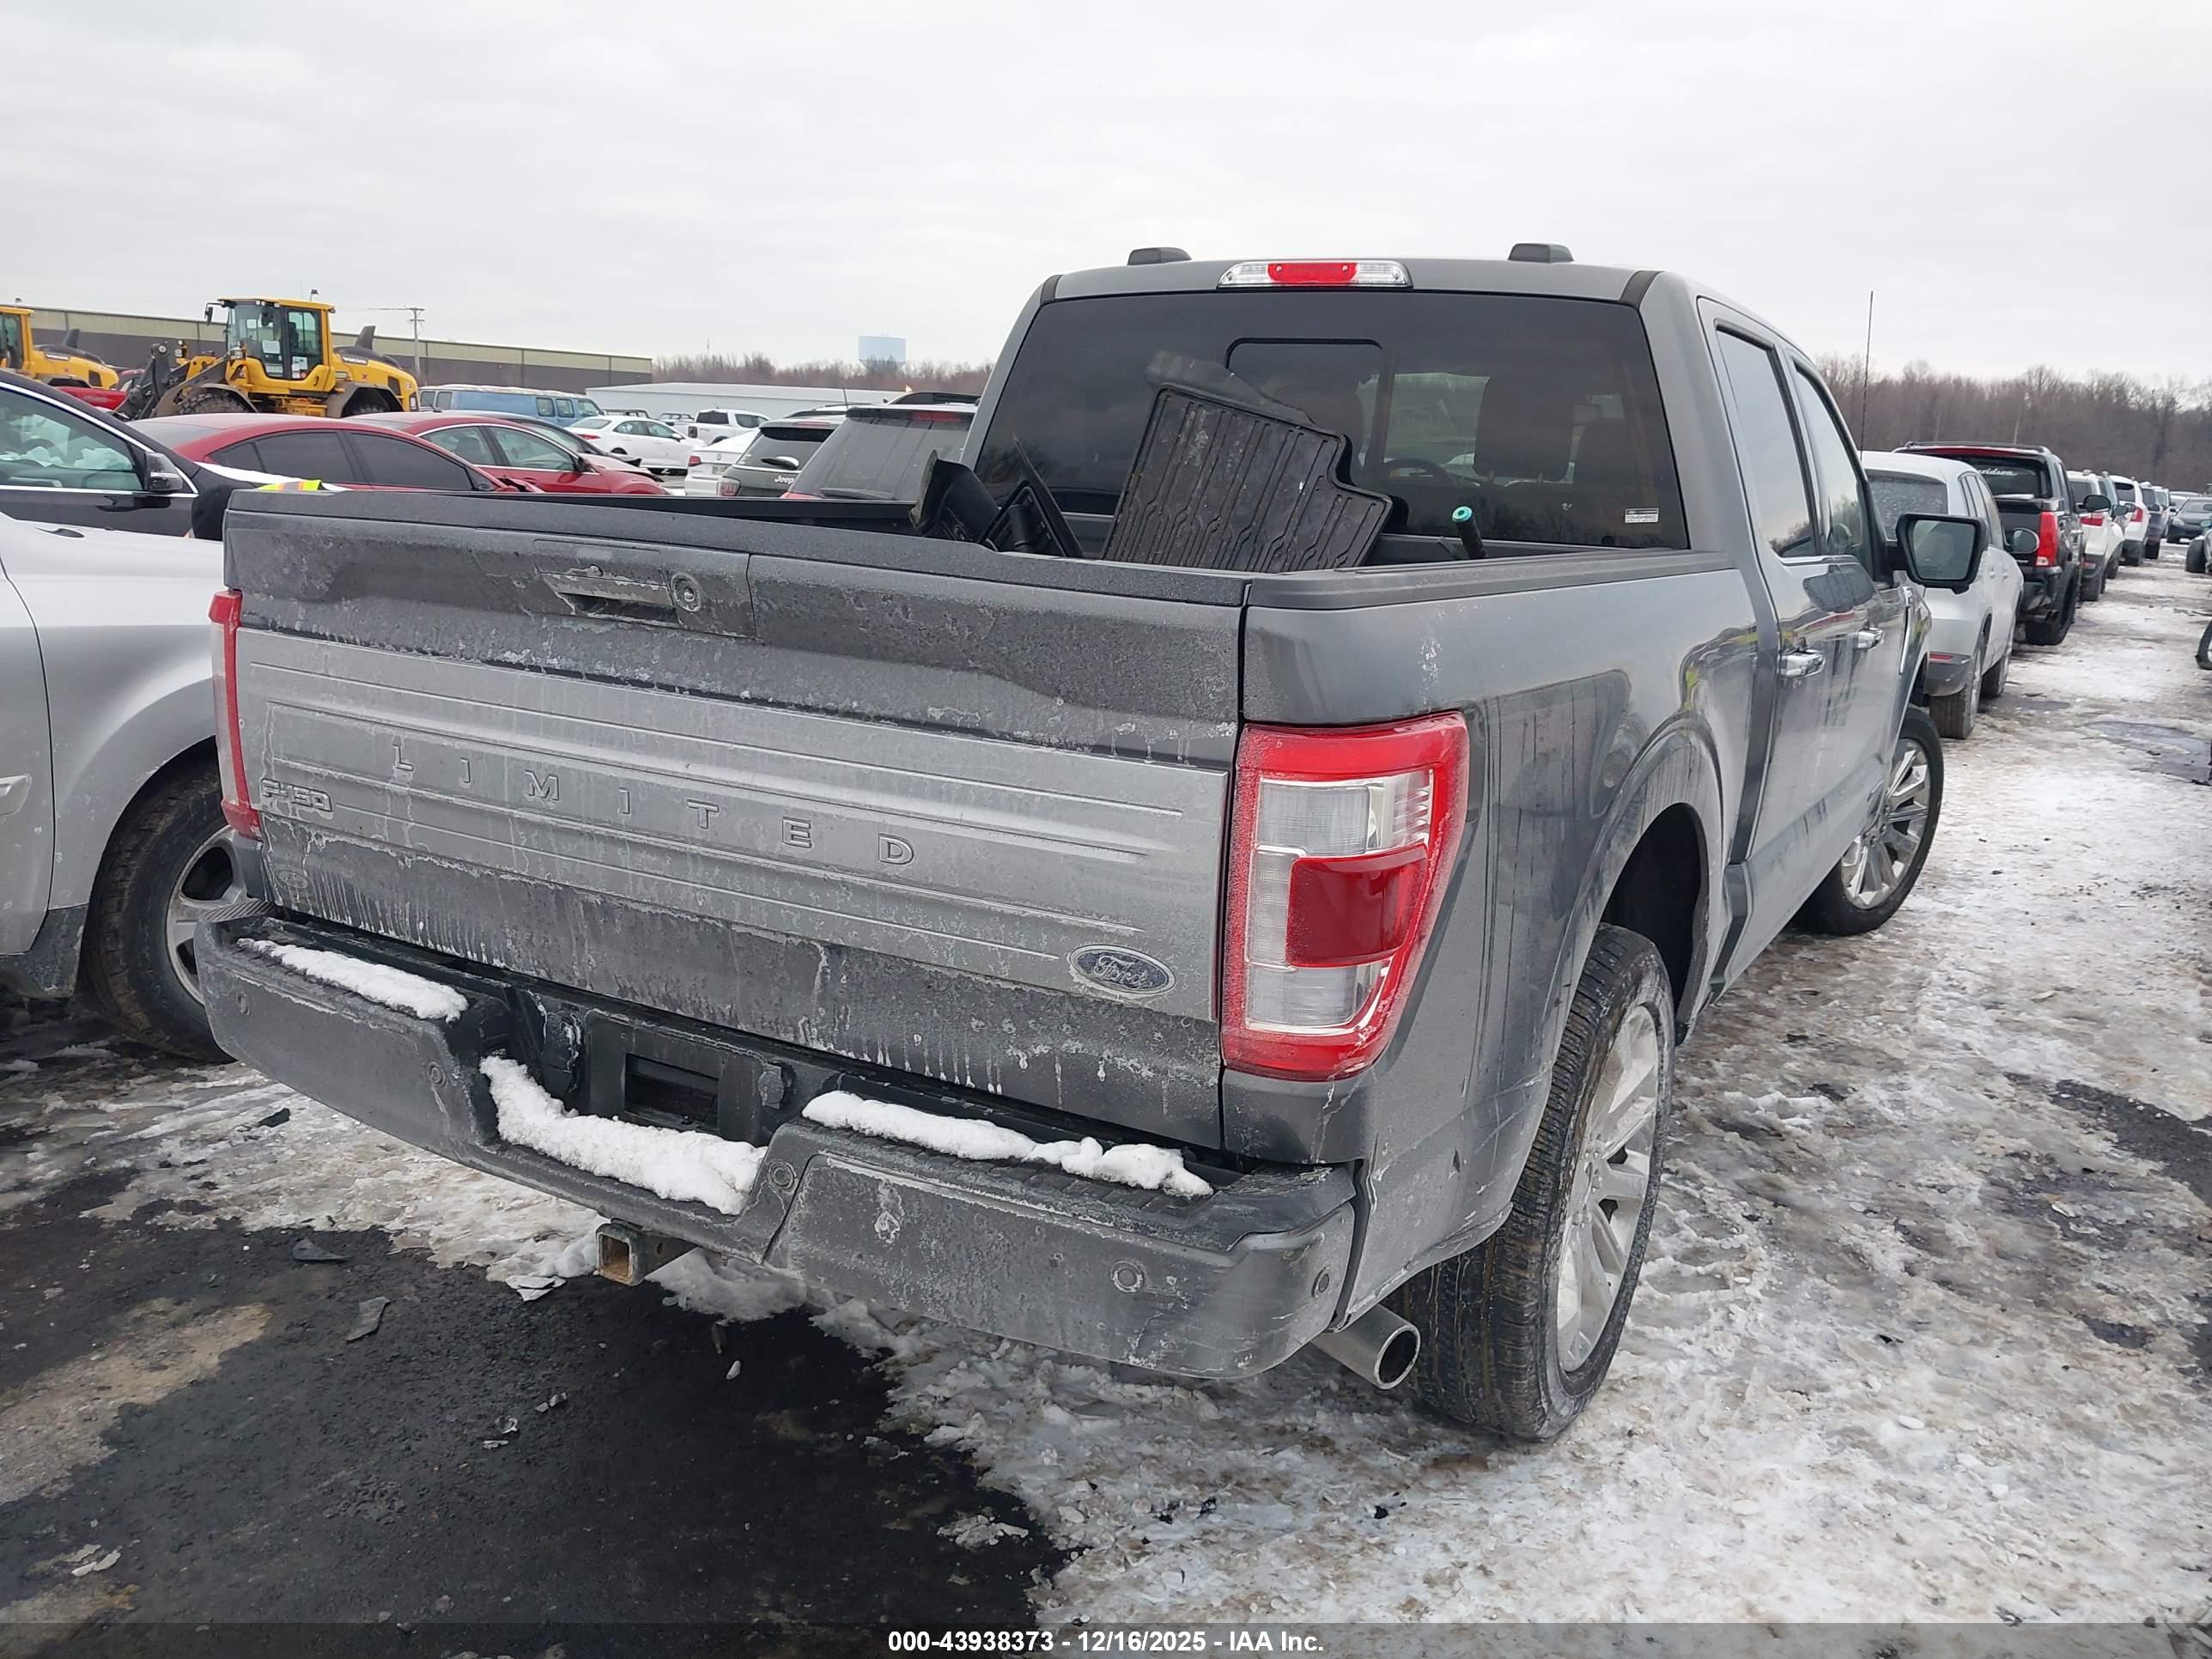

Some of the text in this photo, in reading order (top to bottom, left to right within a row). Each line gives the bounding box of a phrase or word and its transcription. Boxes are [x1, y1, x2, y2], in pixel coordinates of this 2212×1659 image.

[774, 475, 794, 485] Jeep
[392, 744, 915, 866] LIMITED
[1092, 954, 1153, 989] Ford
